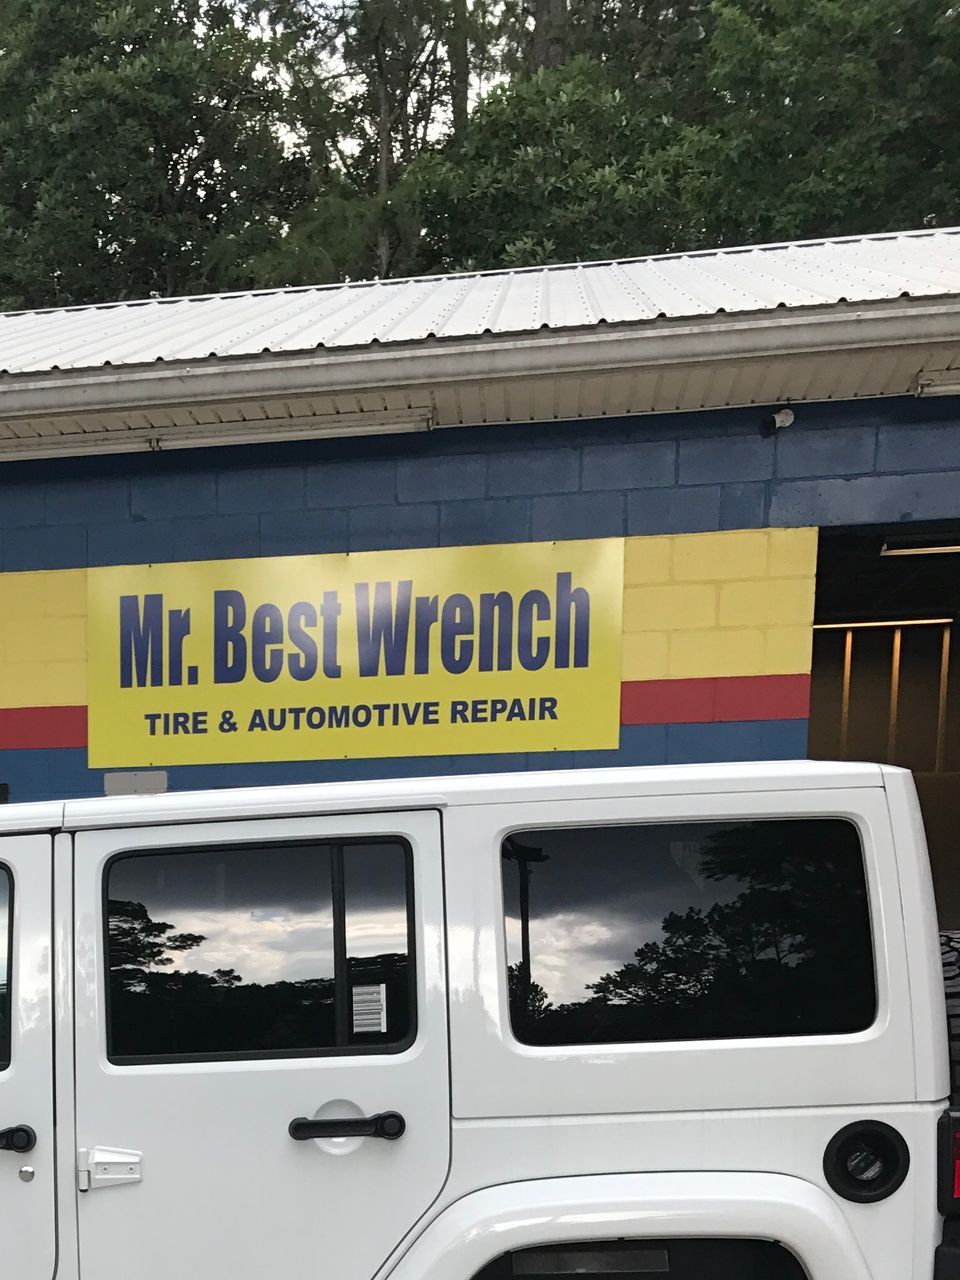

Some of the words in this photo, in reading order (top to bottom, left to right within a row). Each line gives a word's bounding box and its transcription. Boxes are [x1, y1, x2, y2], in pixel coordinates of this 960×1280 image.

[119, 592, 199, 689] Mr.
[213, 588, 342, 685] Best
[354, 571, 591, 678] Wrench
[145, 710, 208, 737] TIRE
[218, 710, 239, 734] &
[248, 701, 440, 733] AUTOMOTIVE
[450, 696, 559, 725] REPAIR
